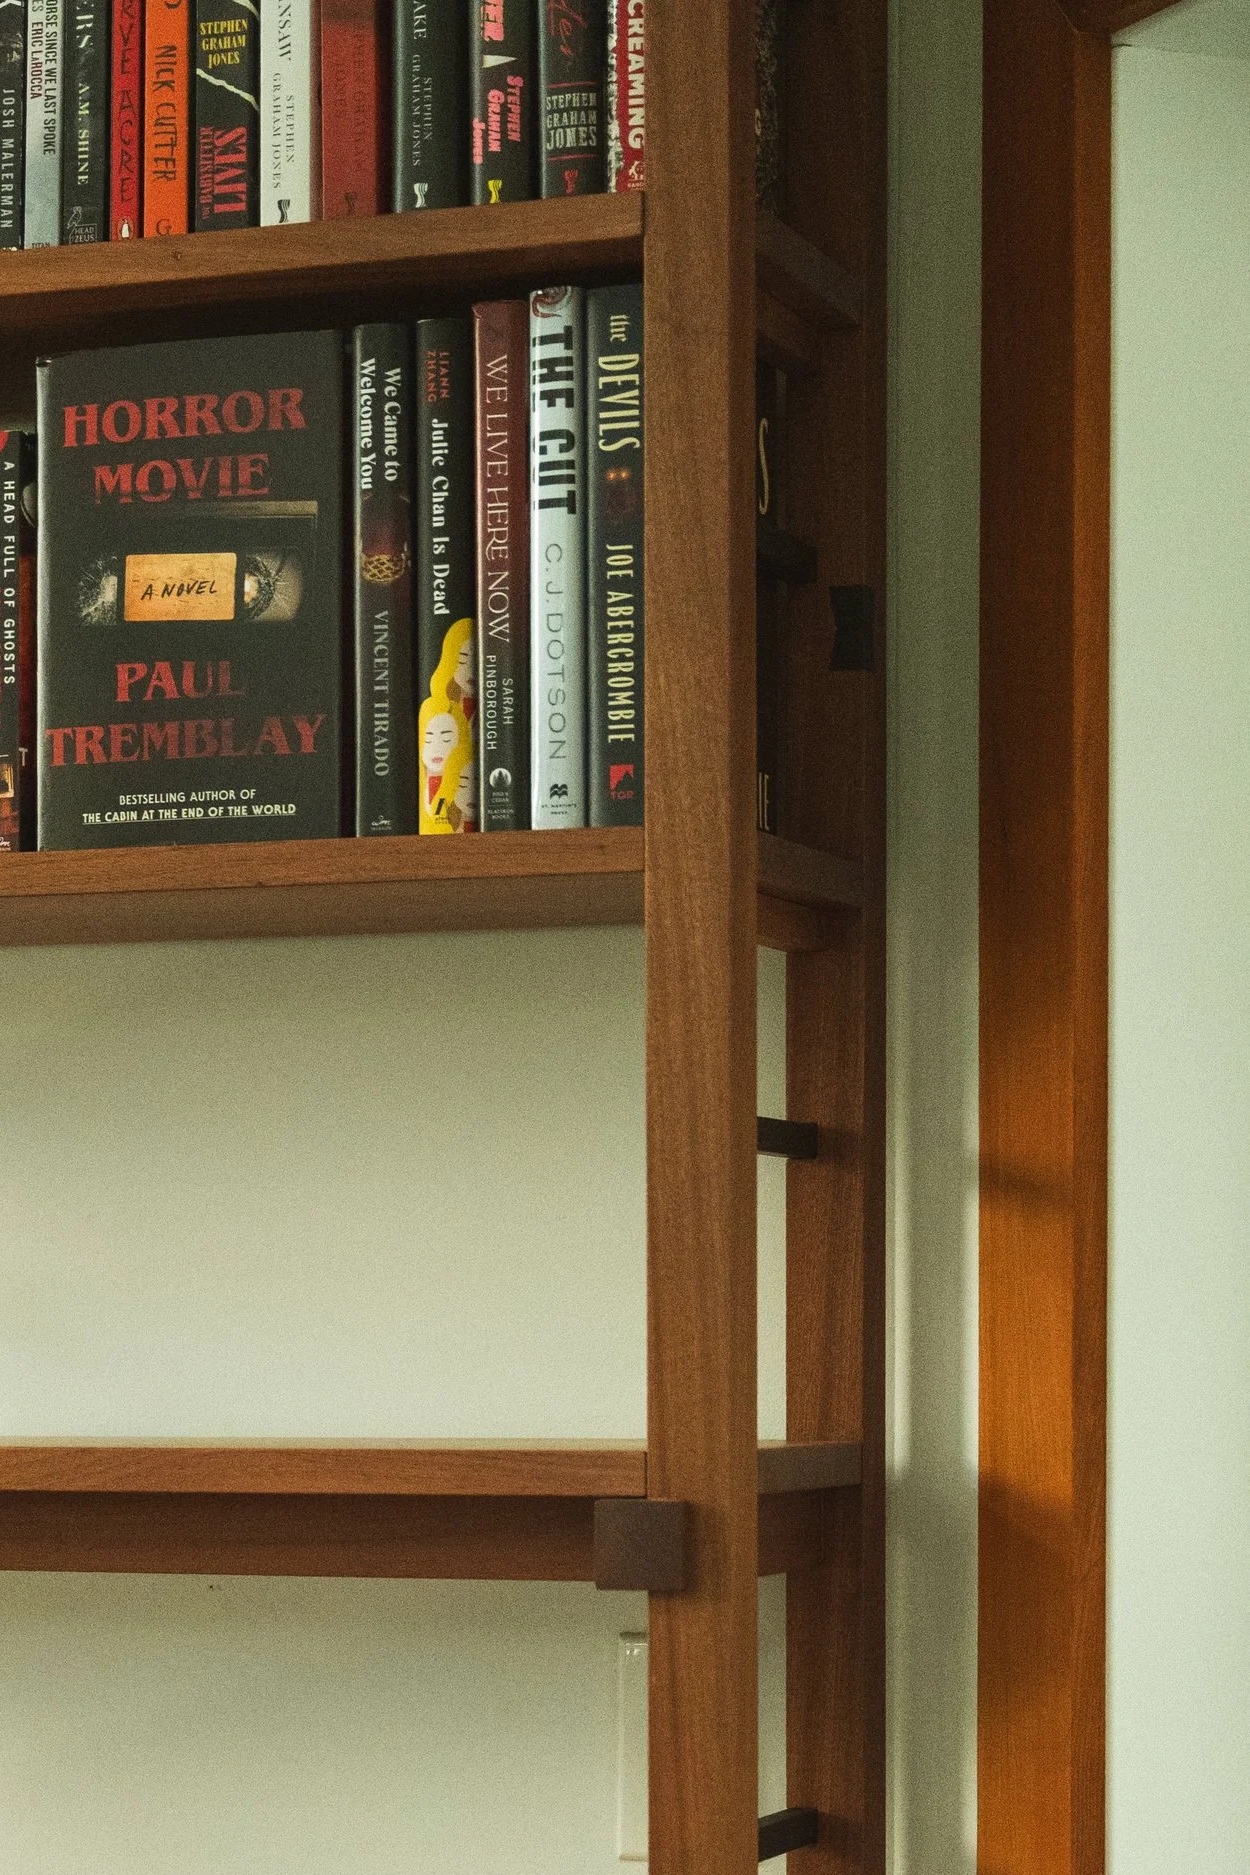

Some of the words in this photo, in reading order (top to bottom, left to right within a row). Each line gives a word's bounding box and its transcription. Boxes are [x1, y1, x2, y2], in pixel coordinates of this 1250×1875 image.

[200, 18, 248, 36] STEPHEN
[202, 34, 246, 51] GRAHAM
[152, 45, 177, 92] NICK
[208, 52, 240, 69] JONES
[2, 89, 15, 128] JOSH
[546, 92, 597, 110] STEPHEN
[547, 109, 597, 128] GRAHAM
[152, 102, 178, 182] CUTTER
[547, 126, 597, 150] JONES
[0, 138, 14, 229] MALERMAN
[610, 314, 629, 343] the
[384, 367, 401, 398] We
[487, 355, 508, 404] WE
[62, 387, 307, 448] HORROR
[360, 358, 377, 449] Welcome
[598, 353, 640, 452] DEVILS
[384, 401, 401, 457] Came
[431, 418, 449, 467] Julie
[487, 412, 508, 478] LIVE
[3, 461, 15, 471] A
[93, 453, 271, 504] MOVIE
[360, 453, 377, 490] You
[385, 463, 401, 482] to
[3, 480, 15, 524] HEAD
[432, 476, 450, 528] Chan
[485, 486, 509, 561] HERE
[3, 535, 15, 578] FULL
[433, 537, 450, 555] Is
[606, 543, 634, 580] JOE
[3, 588, 15, 608] OF
[141, 584, 153, 600] A
[161, 580, 218, 598] NOVEL
[433, 563, 450, 616] Dead
[488, 571, 510, 643] NOW
[3, 619, 15, 685] GHOSTS
[607, 591, 635, 744] ABERCROMBIE
[115, 660, 244, 703] PAUL
[486, 655, 497, 750] PINBOROUGH
[502, 678, 513, 725] SARAH
[44, 713, 327, 767] TREMBLAY
[82, 813, 101, 823] THE
[105, 810, 138, 822] CABIN
[142, 810, 154, 820] AT
[158, 808, 178, 819] THE
[182, 807, 204, 818] END
[208, 806, 224, 817] OF
[228, 805, 248, 816] THE
[252, 804, 296, 815] WORLD
[119, 792, 186, 805] BESTSELLING
[190, 789, 236, 801] AUTHOR
[240, 789, 256, 800] OF
